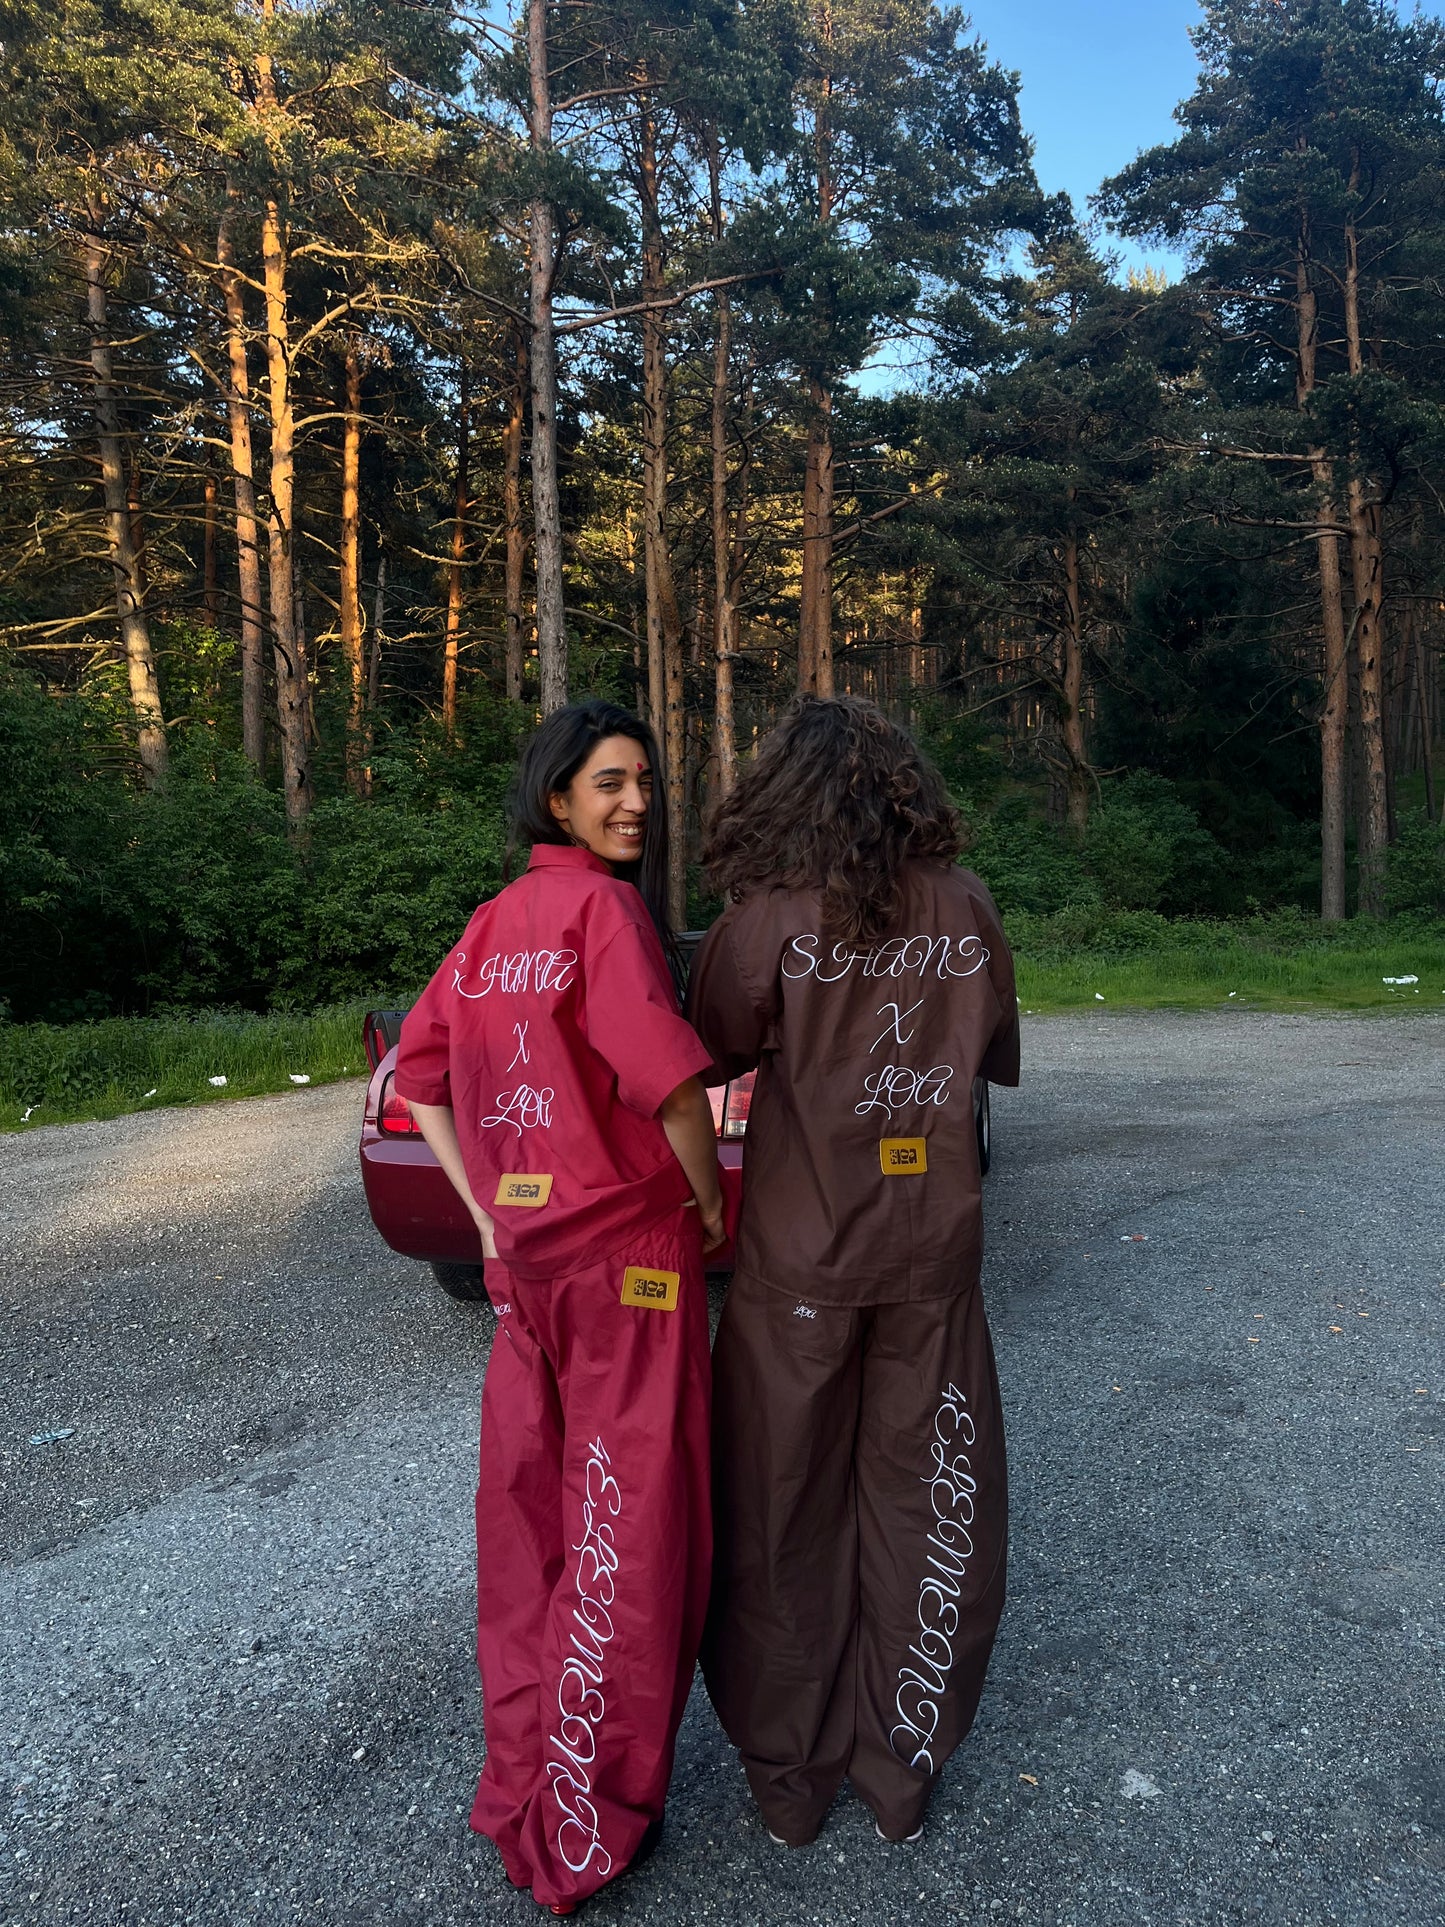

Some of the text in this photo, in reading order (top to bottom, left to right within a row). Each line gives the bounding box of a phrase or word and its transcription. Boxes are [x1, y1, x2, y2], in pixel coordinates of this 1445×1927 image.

[506, 1020, 530, 1073] X
[869, 999, 924, 1054] X
[854, 1064, 954, 1120] LOA
